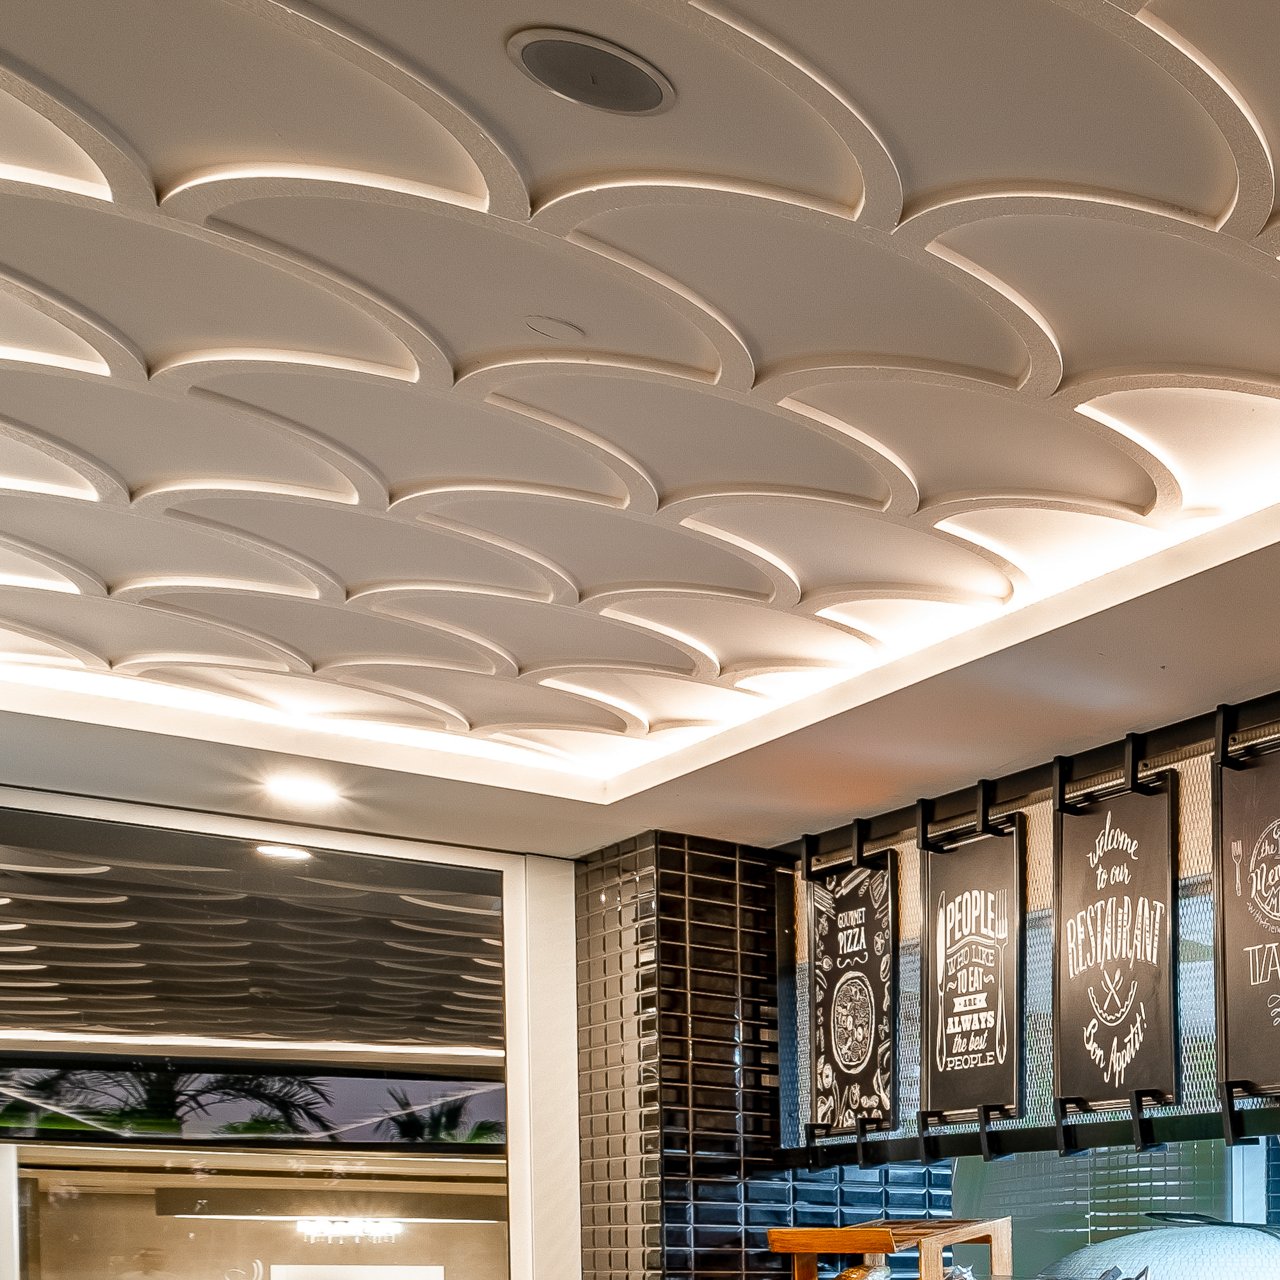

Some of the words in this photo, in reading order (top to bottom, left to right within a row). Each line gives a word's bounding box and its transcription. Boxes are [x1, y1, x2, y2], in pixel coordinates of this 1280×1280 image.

[1258, 840, 1277, 860] the
[1096, 866, 1108, 890] to
[1110, 863, 1131, 885] our
[837, 907, 866, 928] GOURMET
[946, 890, 995, 948] PEOPLE
[838, 927, 867, 955] PIZZA
[1066, 896, 1165, 979] RESTAURANT
[947, 947, 970, 975] WHO
[971, 945, 995, 967] LIKE
[957, 971, 967, 994] TO
[968, 967, 983, 991] EAT
[964, 997, 977, 1006] ARE
[946, 1011, 995, 1034] ALWAYS
[952, 1034, 967, 1053] the
[968, 1030, 988, 1051] best
[1083, 1018, 1106, 1069] Bon
[946, 1052, 995, 1070] PEOPLE
